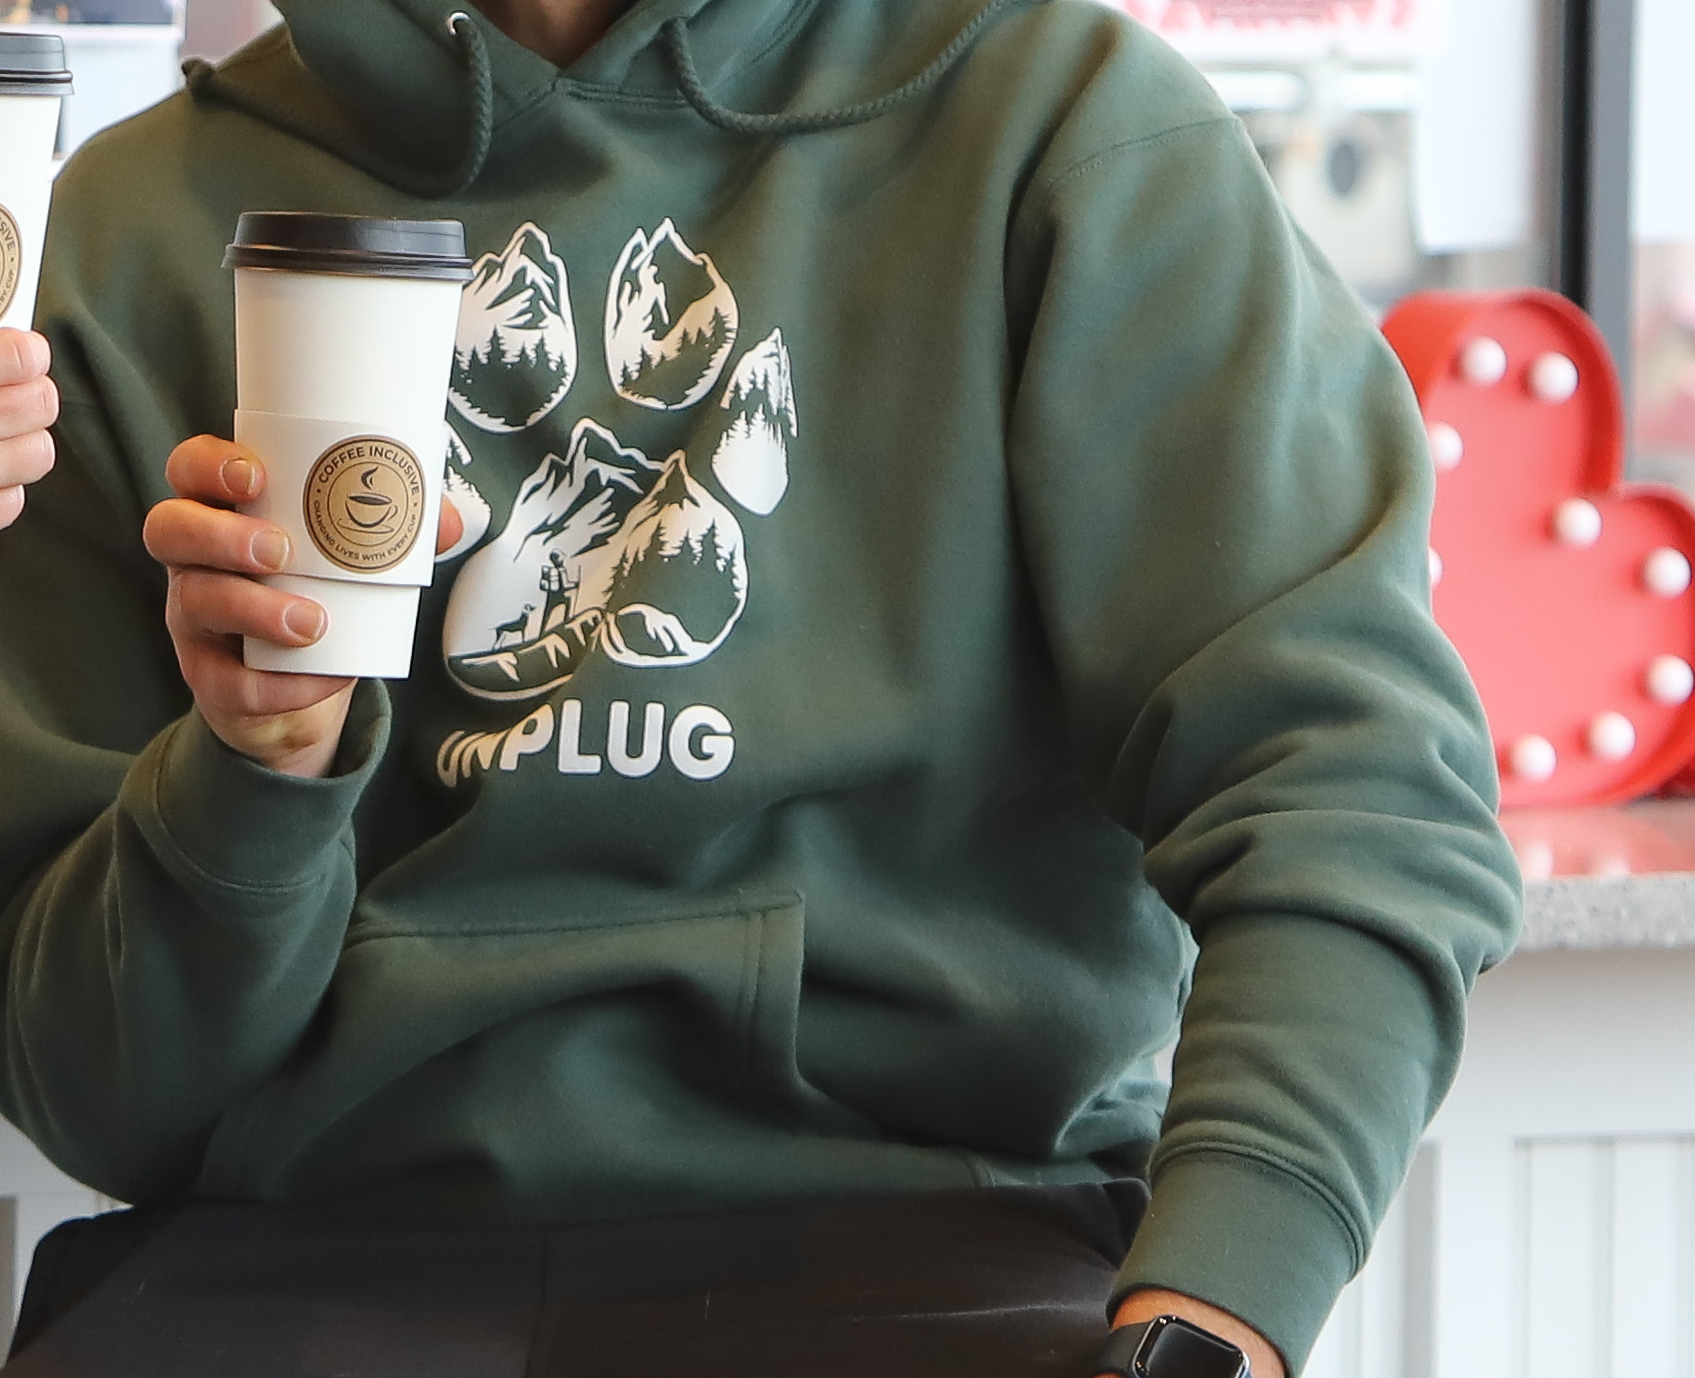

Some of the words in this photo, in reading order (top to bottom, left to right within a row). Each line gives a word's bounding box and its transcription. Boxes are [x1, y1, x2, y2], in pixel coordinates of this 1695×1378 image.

[318, 446, 365, 483] COFFEE
[368, 445, 420, 496] INCLUSIVE
[313, 500, 335, 546] CHANGING
[335, 544, 360, 560] LIVES
[361, 550, 387, 561] WITH
[387, 532, 409, 556] EVERY
[407, 514, 417, 533] CUP
